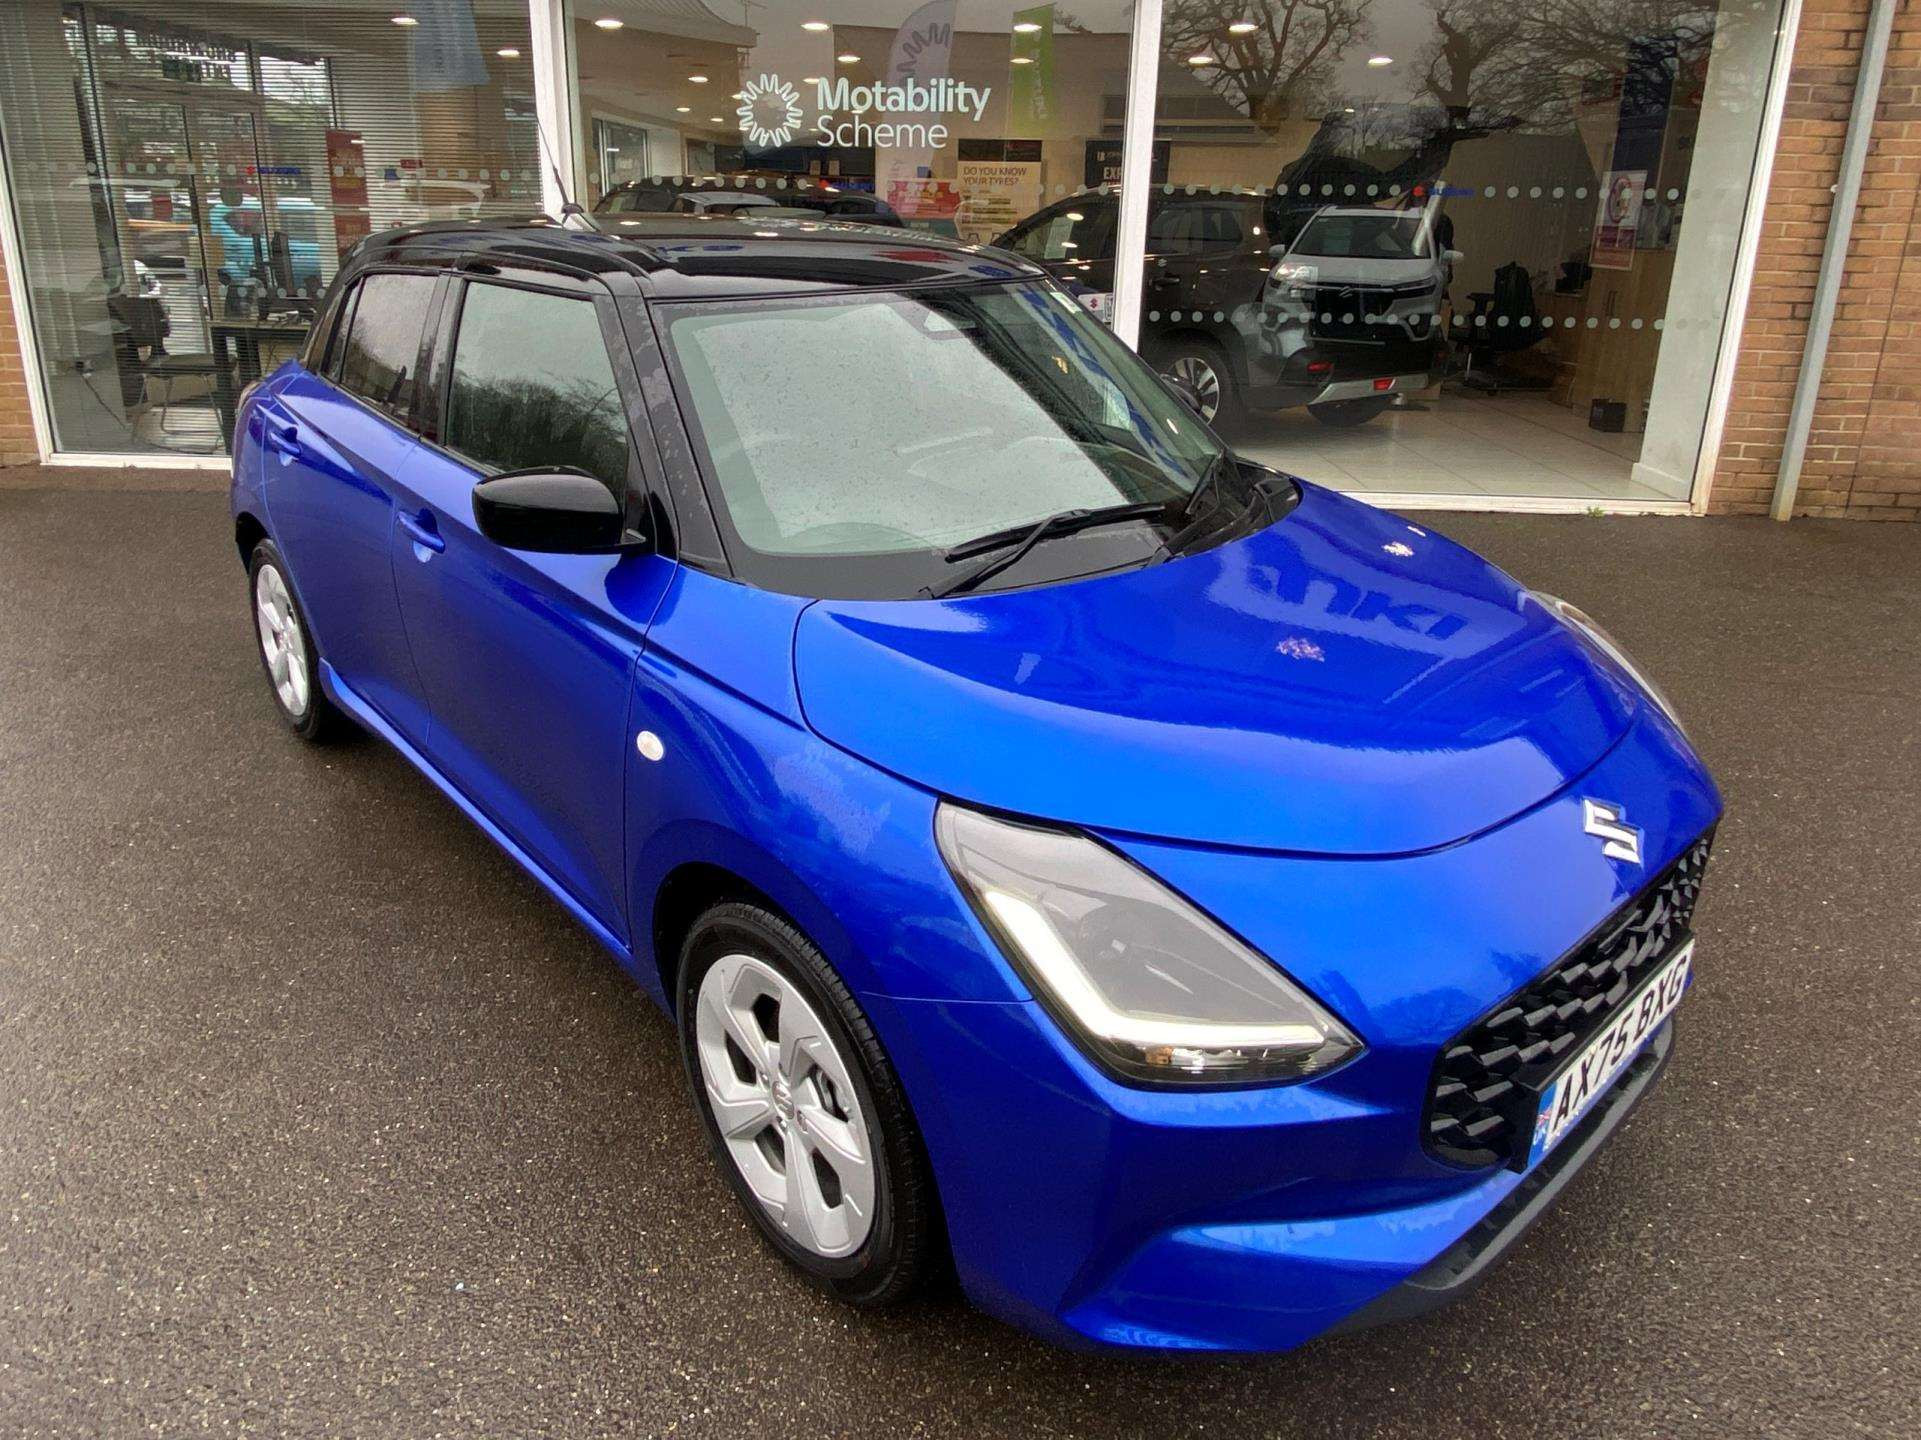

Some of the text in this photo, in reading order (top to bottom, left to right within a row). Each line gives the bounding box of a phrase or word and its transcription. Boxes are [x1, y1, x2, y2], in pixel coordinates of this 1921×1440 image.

[817, 77, 992, 122] Motability
[816, 115, 949, 148] Scheme
[963, 167, 1028, 176] DO YOU KNOW
[963, 177, 987, 185] YOUR
[1552, 954, 1688, 1132] AX75 BXG
